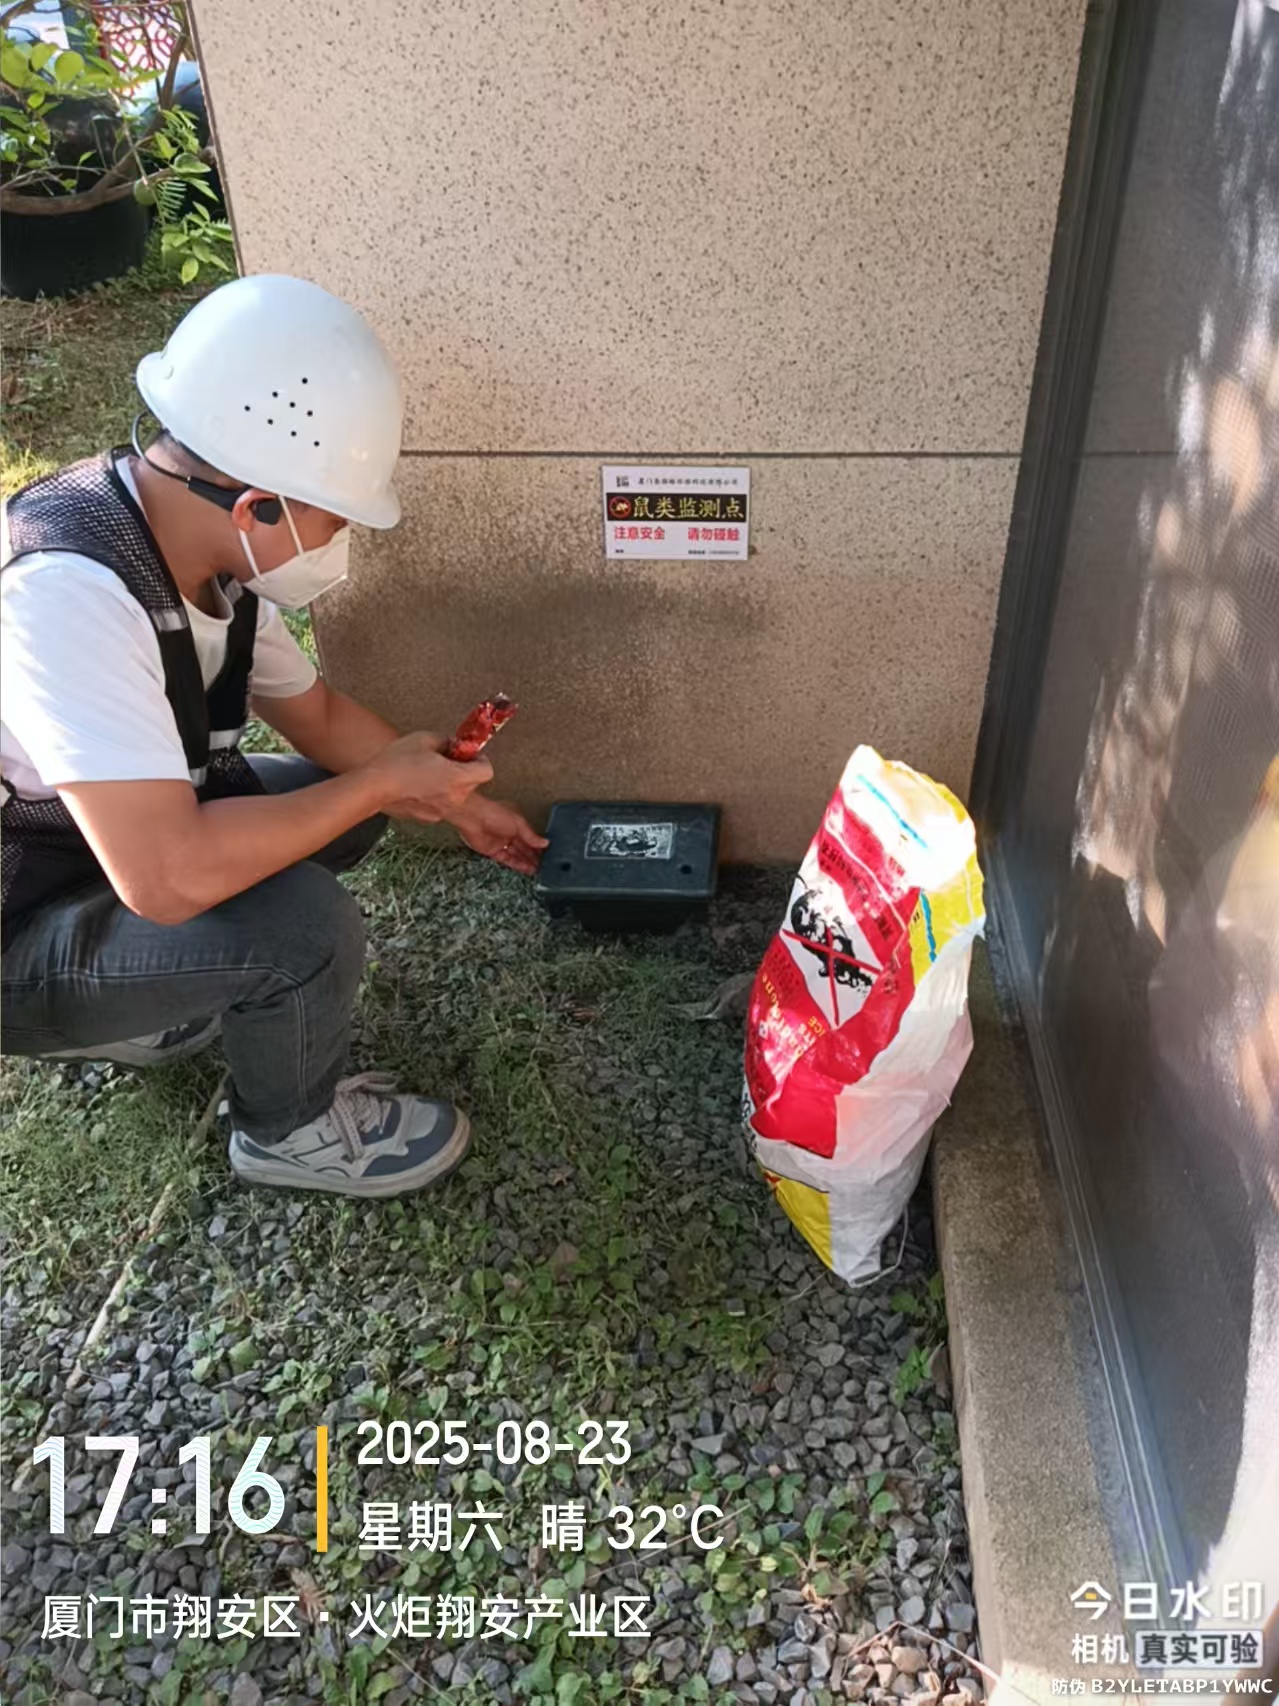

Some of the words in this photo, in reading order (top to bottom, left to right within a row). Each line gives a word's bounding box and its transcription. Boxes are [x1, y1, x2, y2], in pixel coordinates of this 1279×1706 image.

[633, 496, 745, 519] 鼠类监测点
[614, 526, 665, 540] 注意安全
